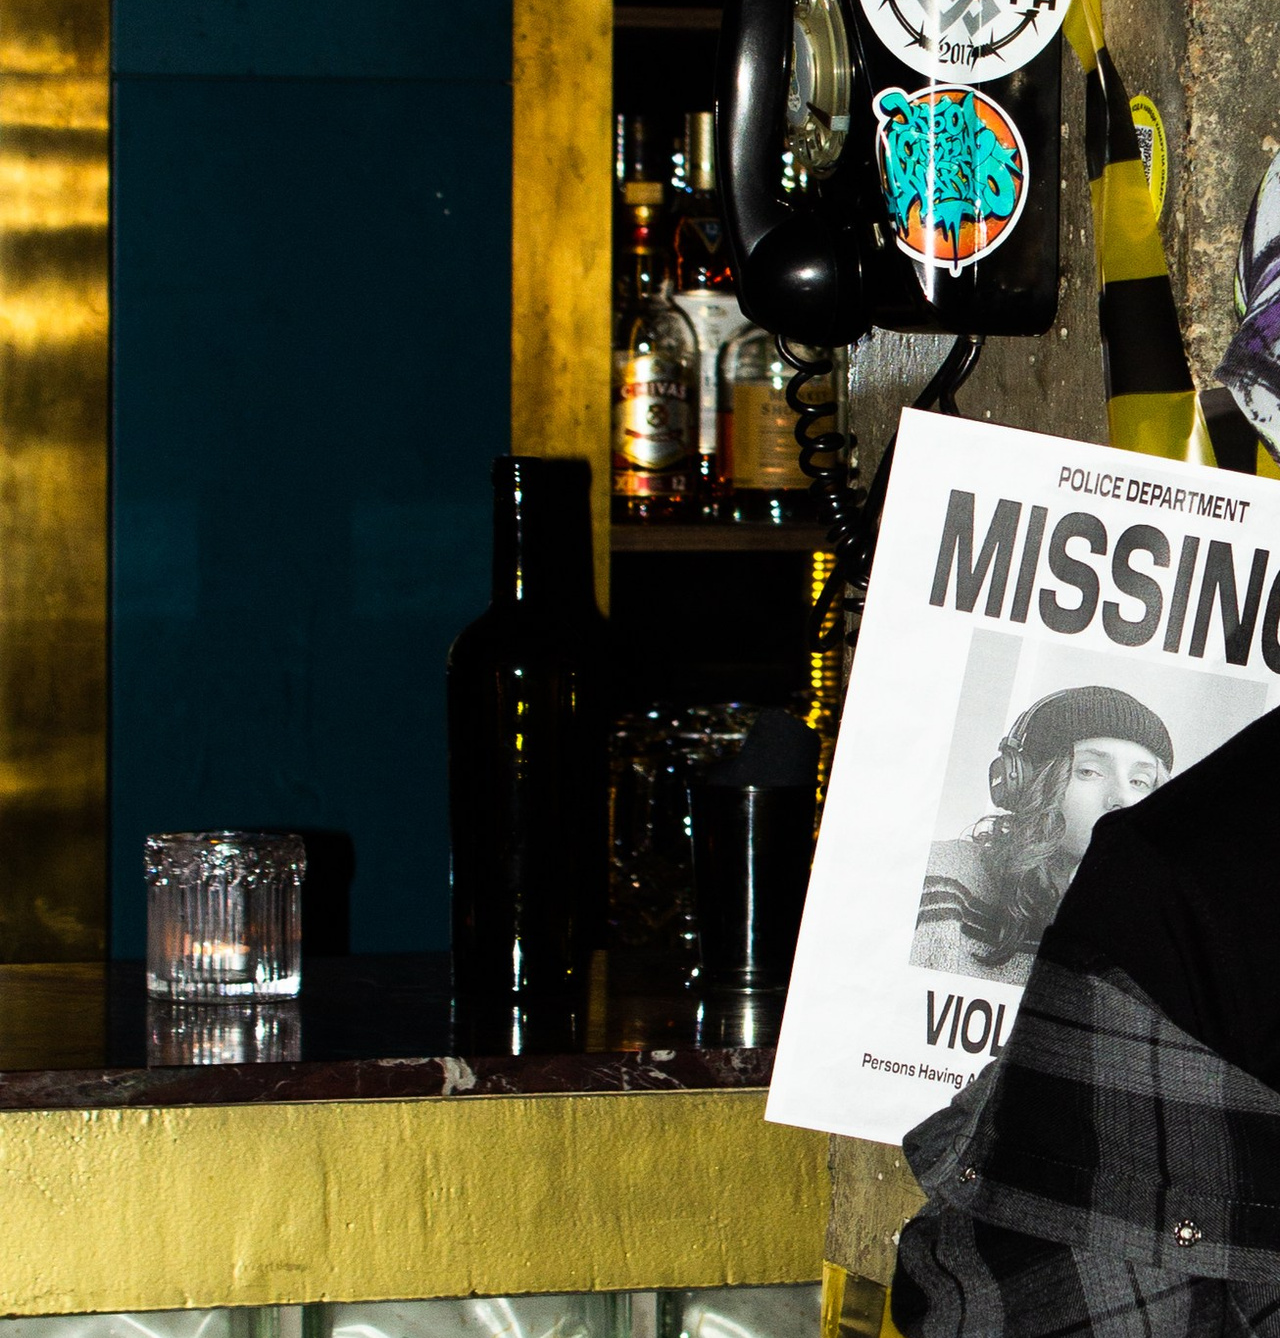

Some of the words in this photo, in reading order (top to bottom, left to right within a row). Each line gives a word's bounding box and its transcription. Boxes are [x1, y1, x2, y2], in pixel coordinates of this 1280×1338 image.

[938, 42, 975, 65] 2017
[1058, 466, 1125, 499] POLICE
[1125, 479, 1251, 523] DEPARTMENT
[862, 1053, 916, 1077] Persons
[918, 1063, 963, 1089] Having
